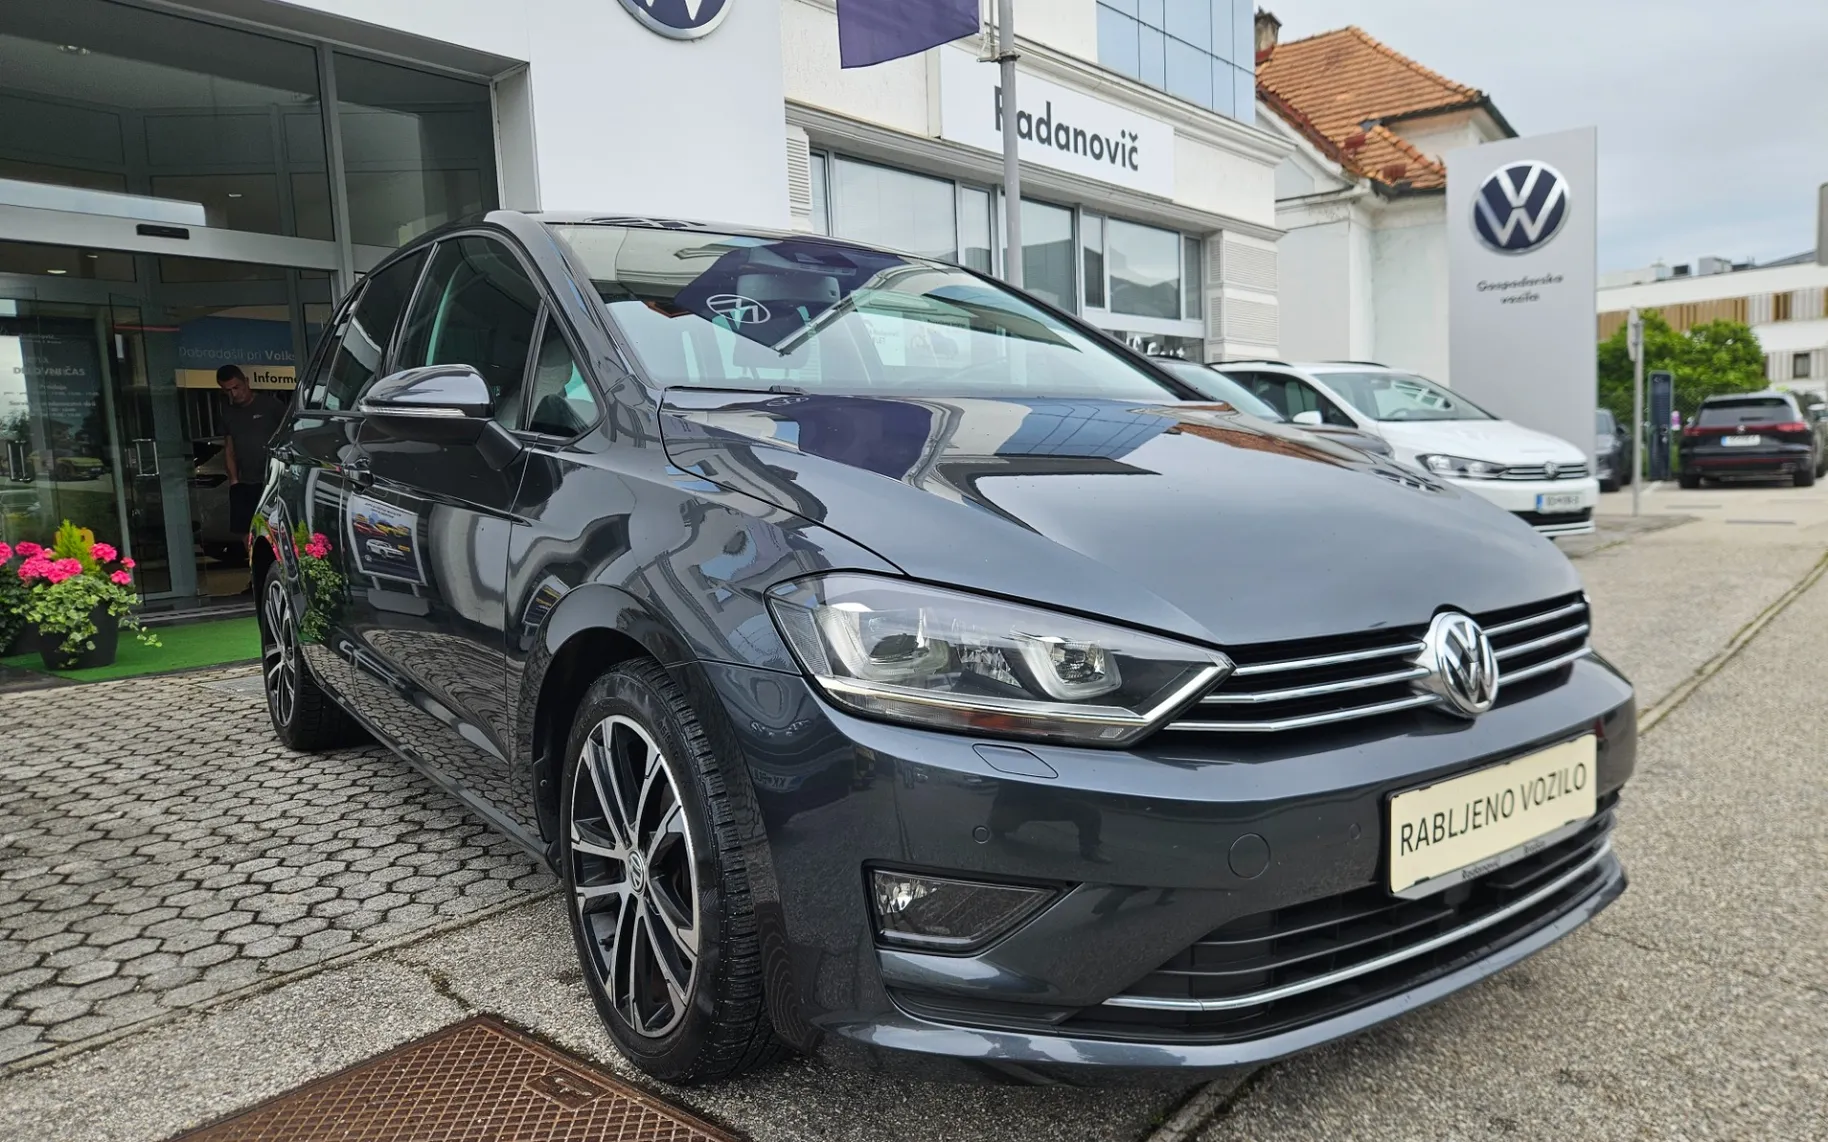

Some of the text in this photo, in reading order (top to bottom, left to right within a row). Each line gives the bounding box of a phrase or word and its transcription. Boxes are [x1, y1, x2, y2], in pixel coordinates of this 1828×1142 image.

[178, 346, 244, 359] Dobrodošli
[247, 350, 262, 361] pri
[1400, 762, 1586, 857] RABLJENO VOZILO
